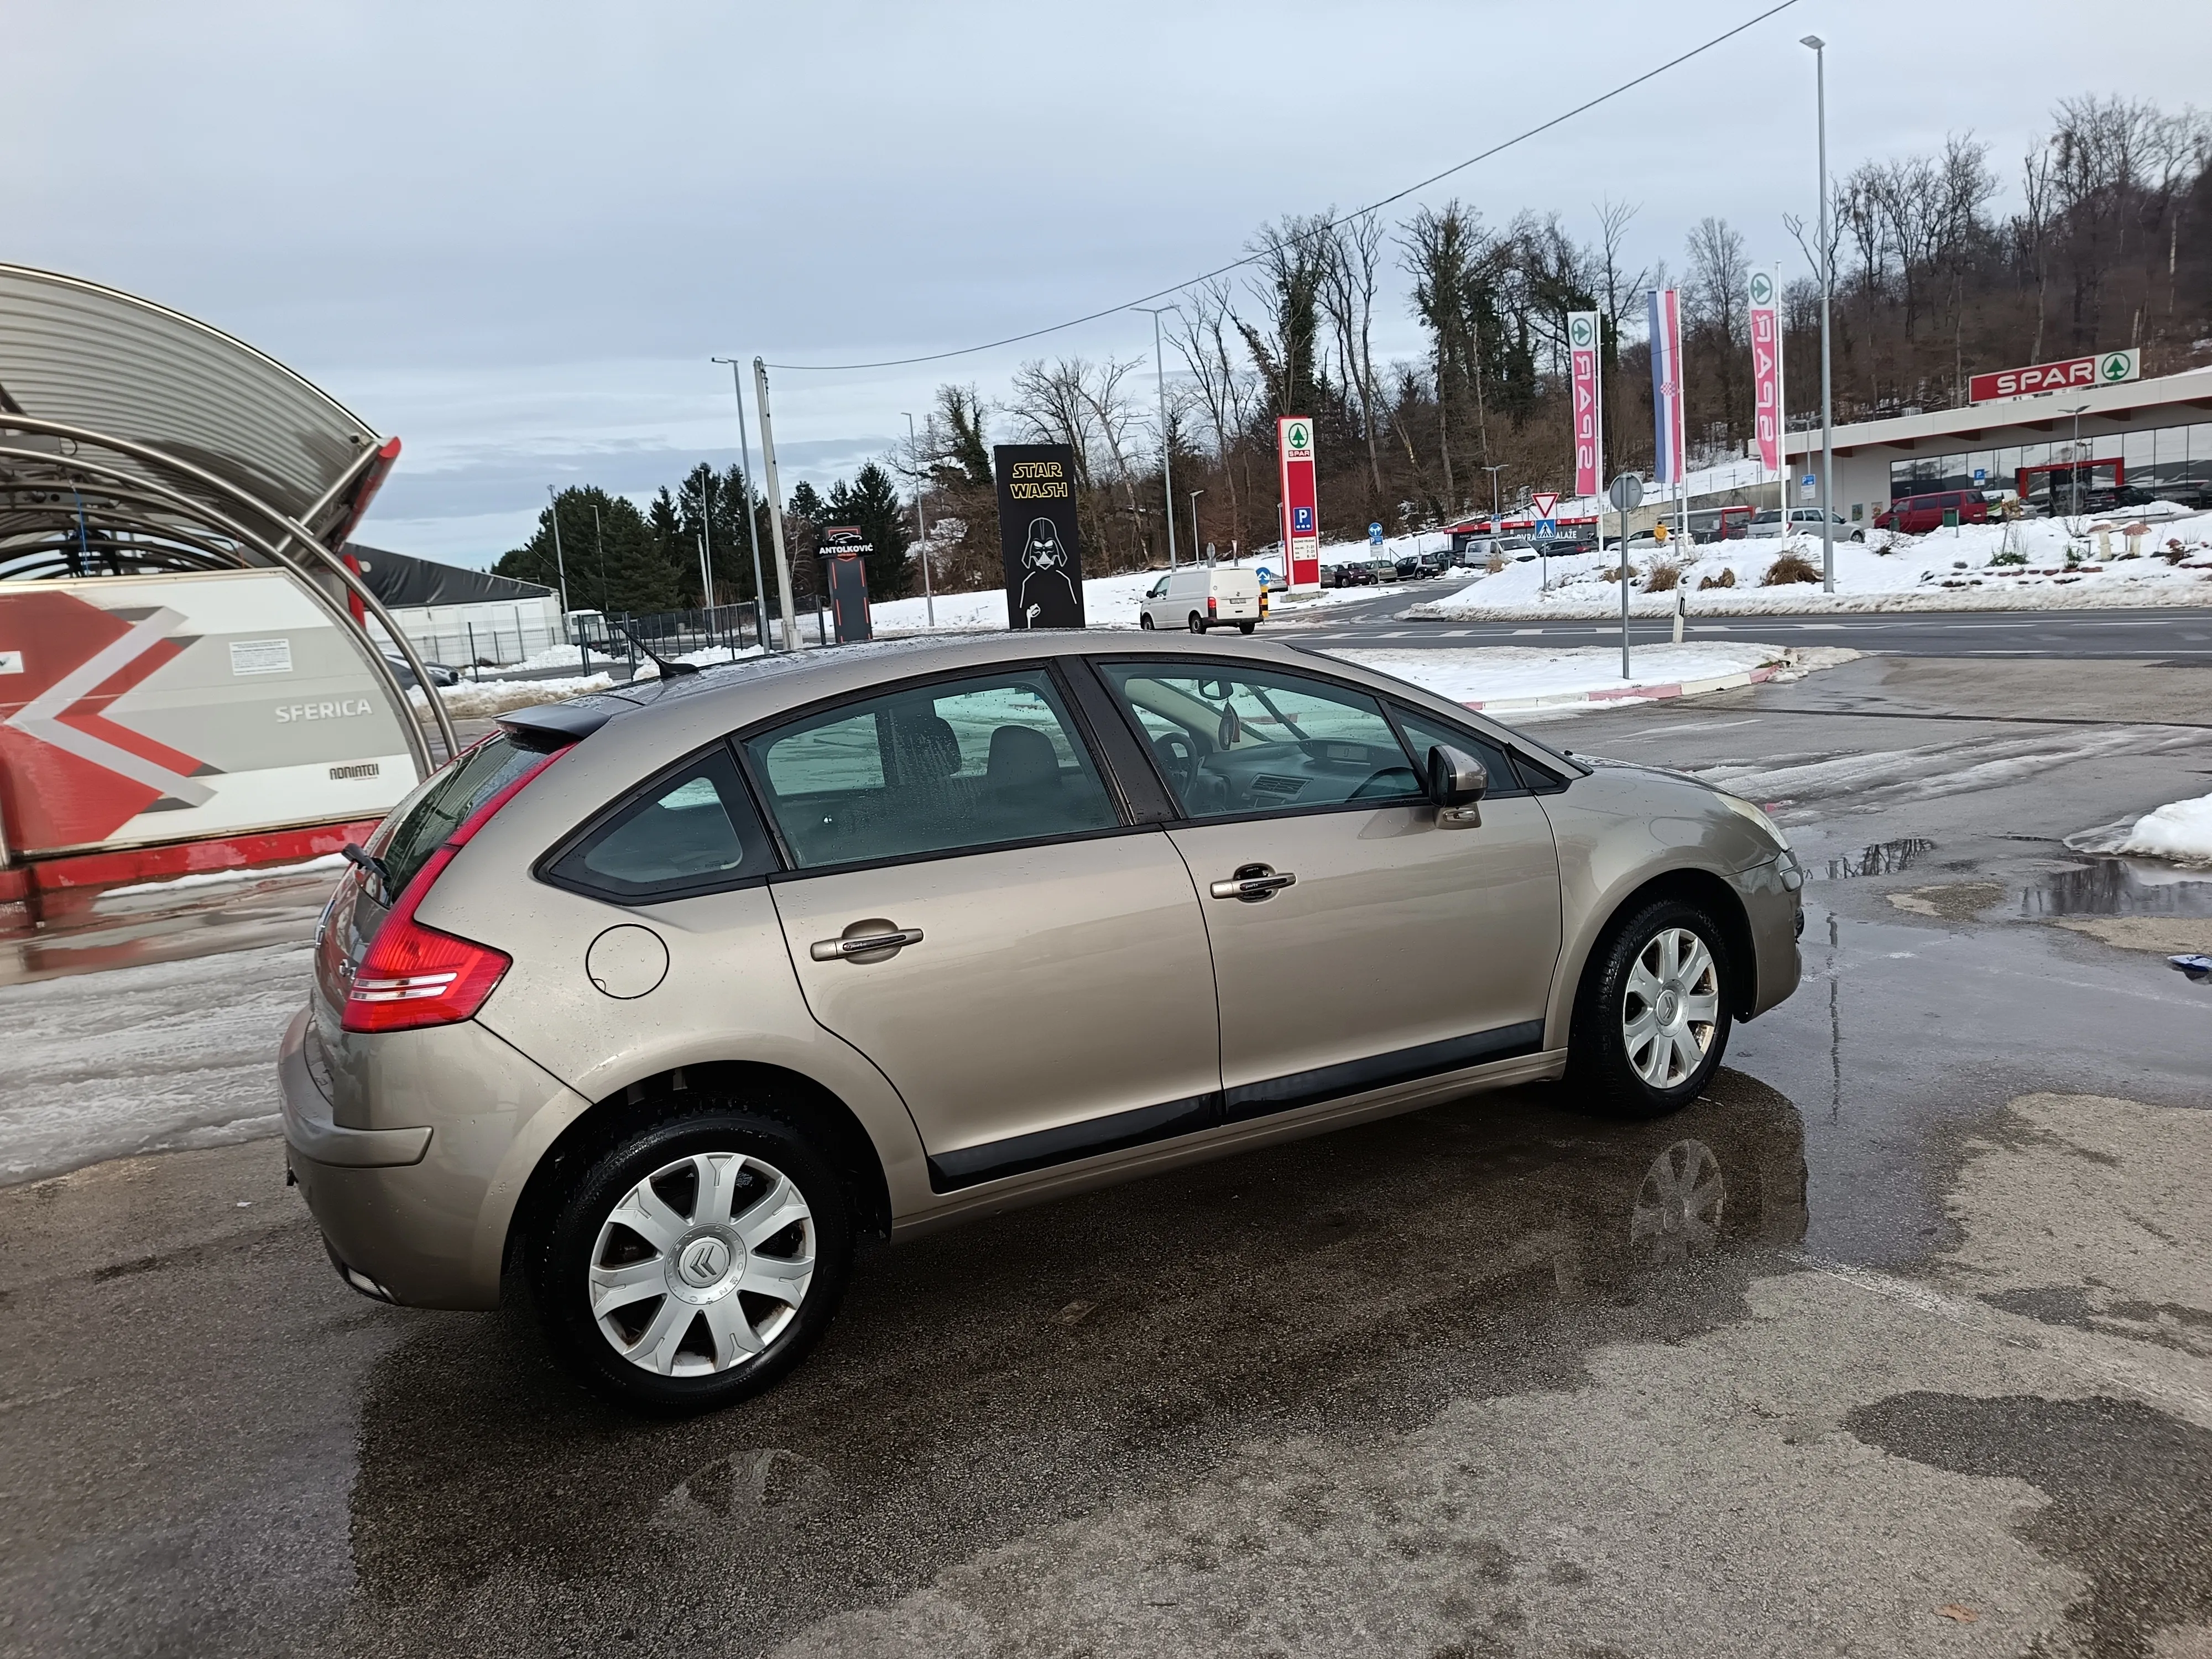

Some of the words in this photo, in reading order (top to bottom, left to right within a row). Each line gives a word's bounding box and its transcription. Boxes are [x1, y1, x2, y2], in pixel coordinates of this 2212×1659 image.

[1997, 362, 2093, 394] SPAR
[1012, 462, 1063, 478] STAR
[1009, 482, 1068, 499] WASH
[1555, 528, 1577, 539] ALAŽE
[819, 543, 874, 554] ANTOLKOVIĆ
[275, 698, 373, 723] SFERICA
